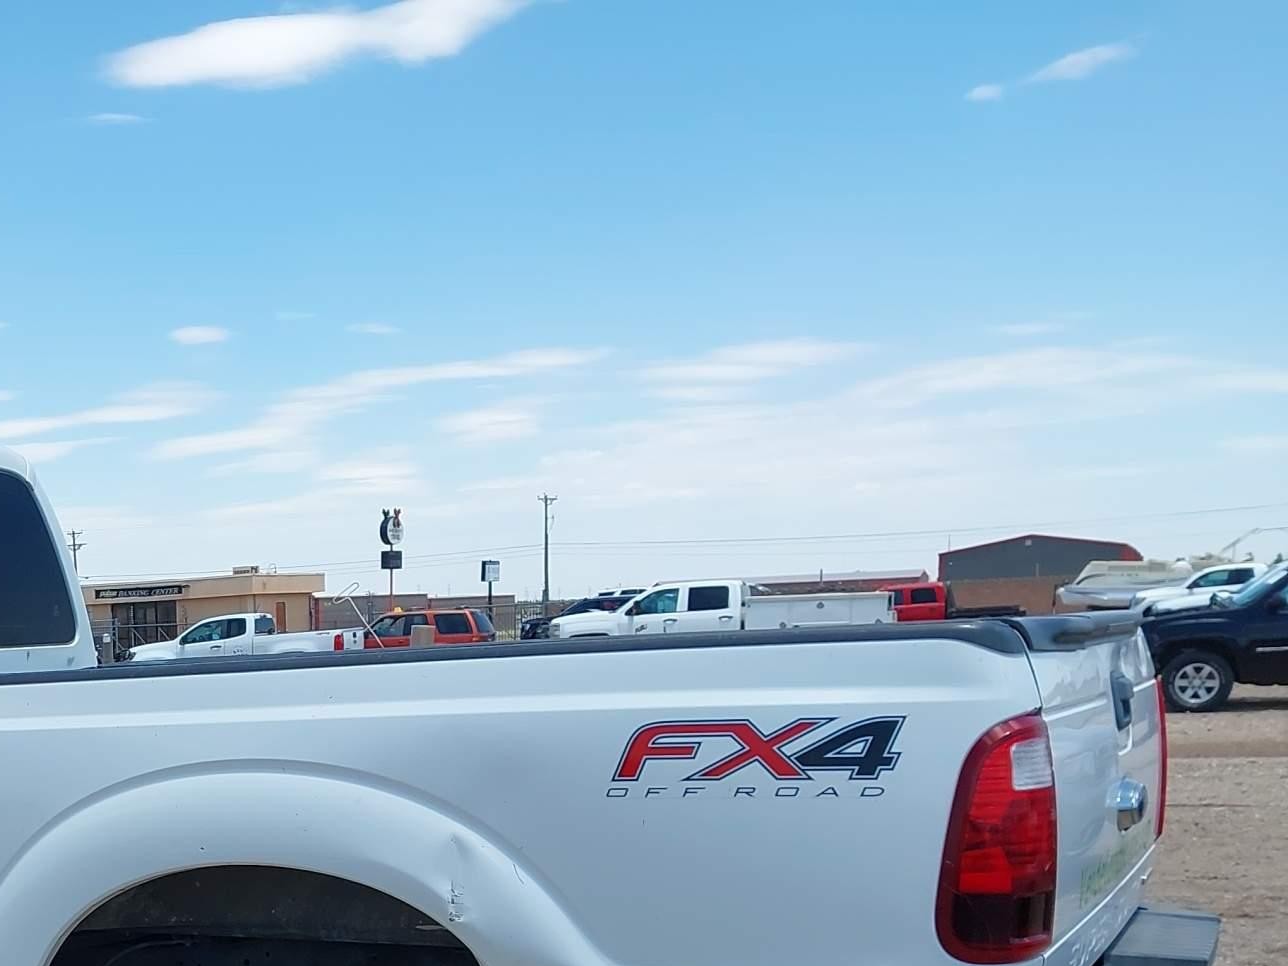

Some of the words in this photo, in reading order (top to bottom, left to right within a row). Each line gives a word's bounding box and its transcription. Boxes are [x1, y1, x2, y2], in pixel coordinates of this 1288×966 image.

[611, 715, 908, 782] FX4
[605, 786, 707, 798] OFF
[733, 786, 885, 798] ROAD
